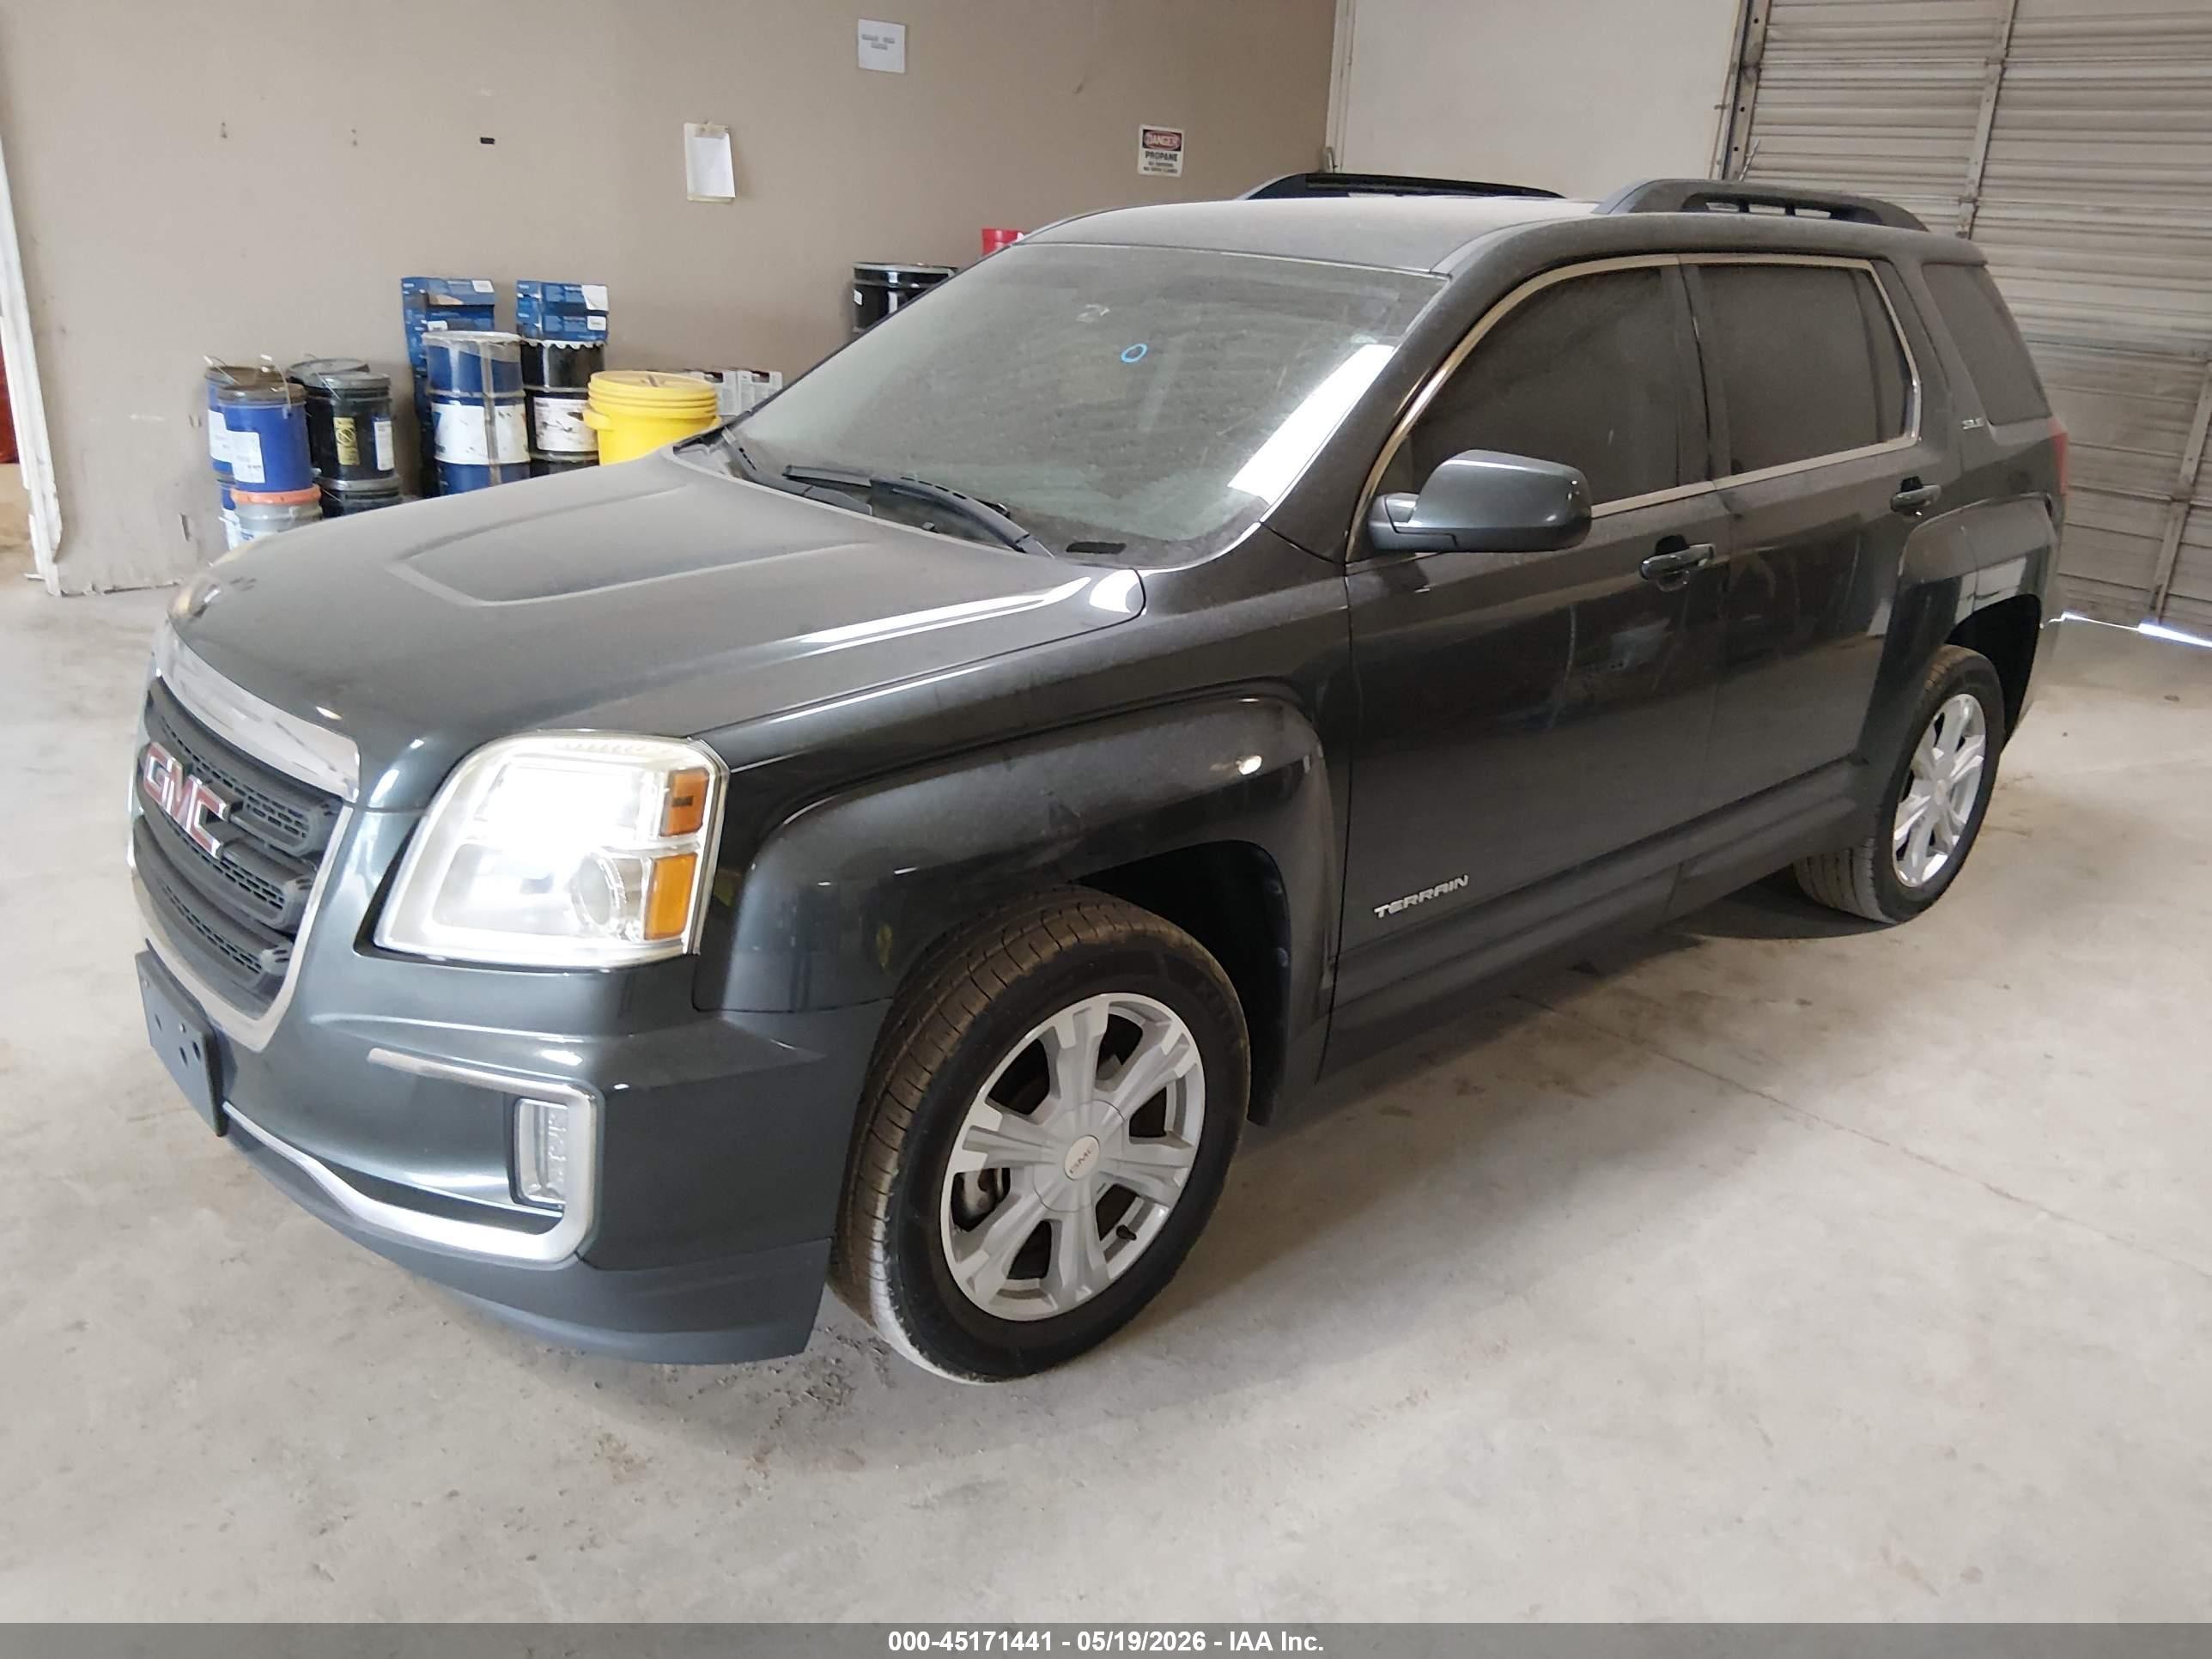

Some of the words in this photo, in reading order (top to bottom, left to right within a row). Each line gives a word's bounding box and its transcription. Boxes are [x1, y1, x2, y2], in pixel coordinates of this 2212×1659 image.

[1145, 132, 1179, 148] DANGER
[1145, 150, 1178, 161] PROPANE
[143, 741, 228, 859] GMC
[1374, 874, 1468, 918] TERRAIN
